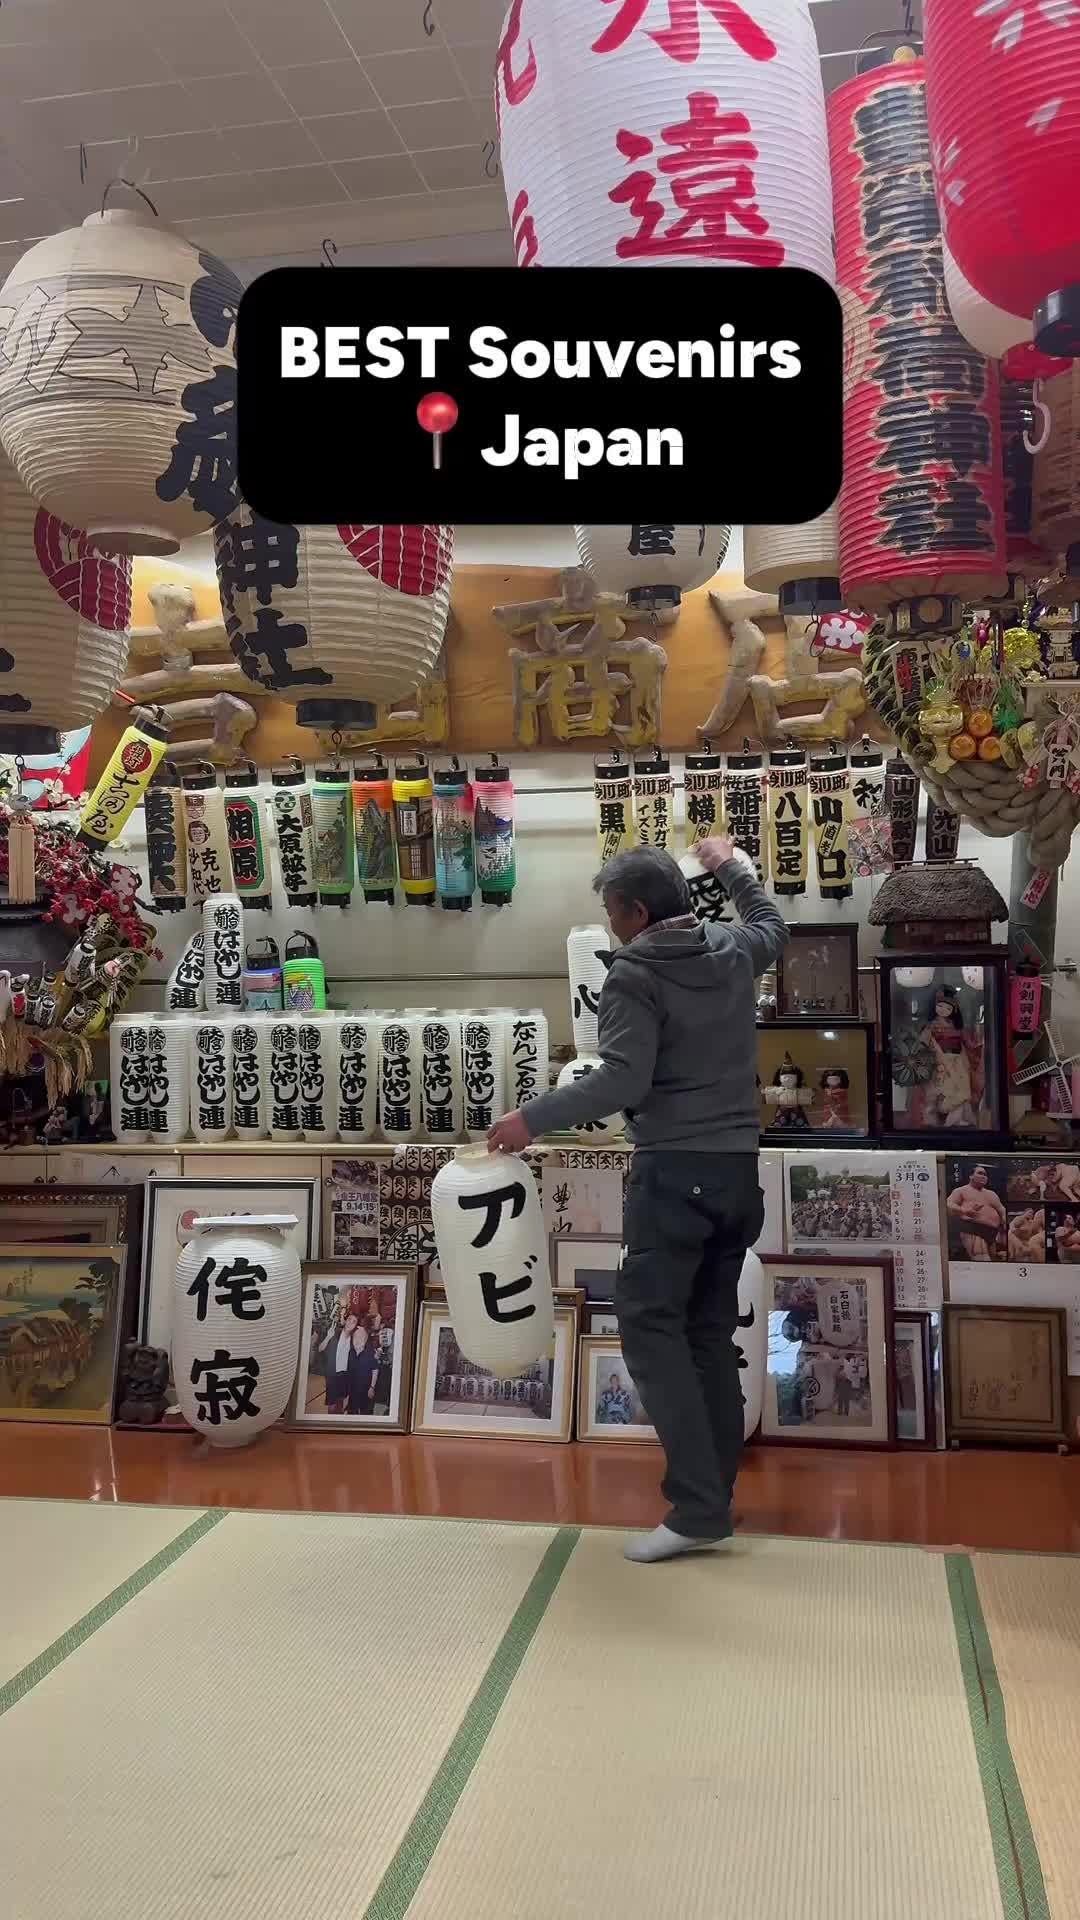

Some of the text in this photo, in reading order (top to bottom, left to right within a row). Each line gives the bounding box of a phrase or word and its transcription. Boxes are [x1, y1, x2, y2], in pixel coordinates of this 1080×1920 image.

[226, 807, 259, 880] 相原
[638, 804, 651, 845] イズミ
[775, 791, 802, 876] 八百定
[201, 847, 221, 893] 克也
[214, 930, 242, 1006] はやし連
[120, 1054, 150, 1132] はやし連
[197, 1055, 226, 1131] はやし連
[232, 1053, 261, 1129] はやし連
[270, 1052, 300, 1131] はやし連
[299, 1052, 326, 1132] はやし連
[338, 1051, 367, 1132] はやし連
[382, 1054, 412, 1132] はやし連
[422, 1052, 455, 1133] はやし連
[464, 1050, 495, 1131] はやし連
[457, 1181, 538, 1323] アビ
[1019, 1267, 1028, 1278] 3
[187, 1256, 268, 1425] 侘寂
